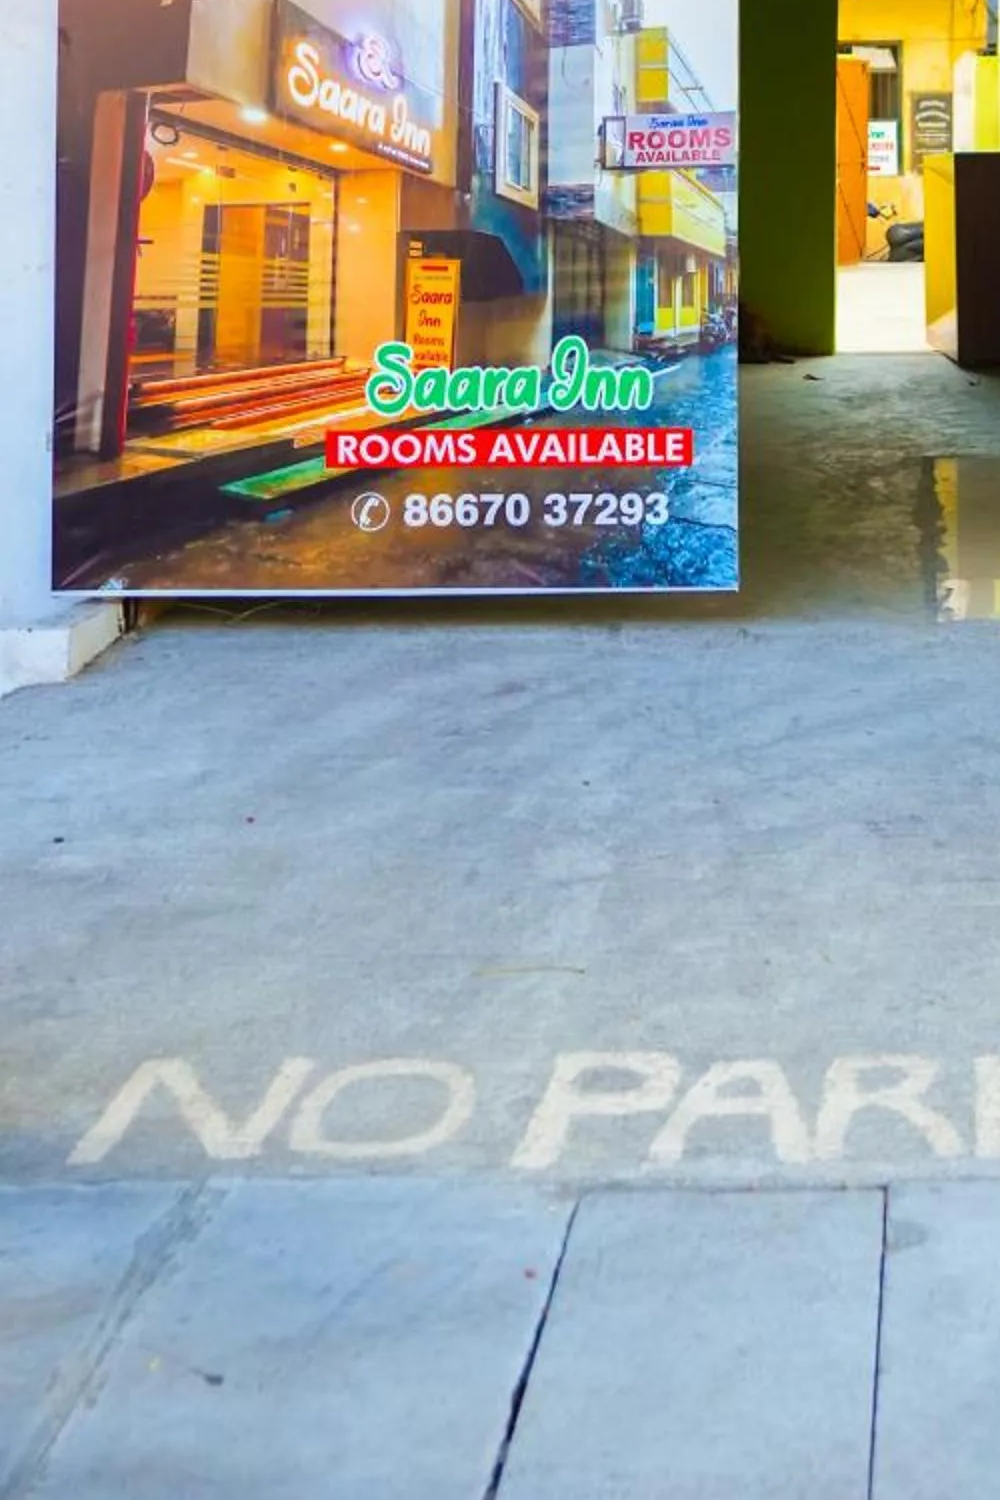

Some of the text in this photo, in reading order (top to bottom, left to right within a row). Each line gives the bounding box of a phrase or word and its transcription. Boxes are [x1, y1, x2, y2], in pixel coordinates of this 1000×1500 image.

[287, 42, 431, 157] Saara Inn
[628, 128, 731, 150] ROOMS
[636, 149, 721, 164] AVAILABLE
[366, 335, 654, 417] Saara Inn
[337, 433, 685, 463] ROOMS AVAILABLE
[403, 492, 670, 526] 86670 37293
[65, 1056, 478, 1165] NO
